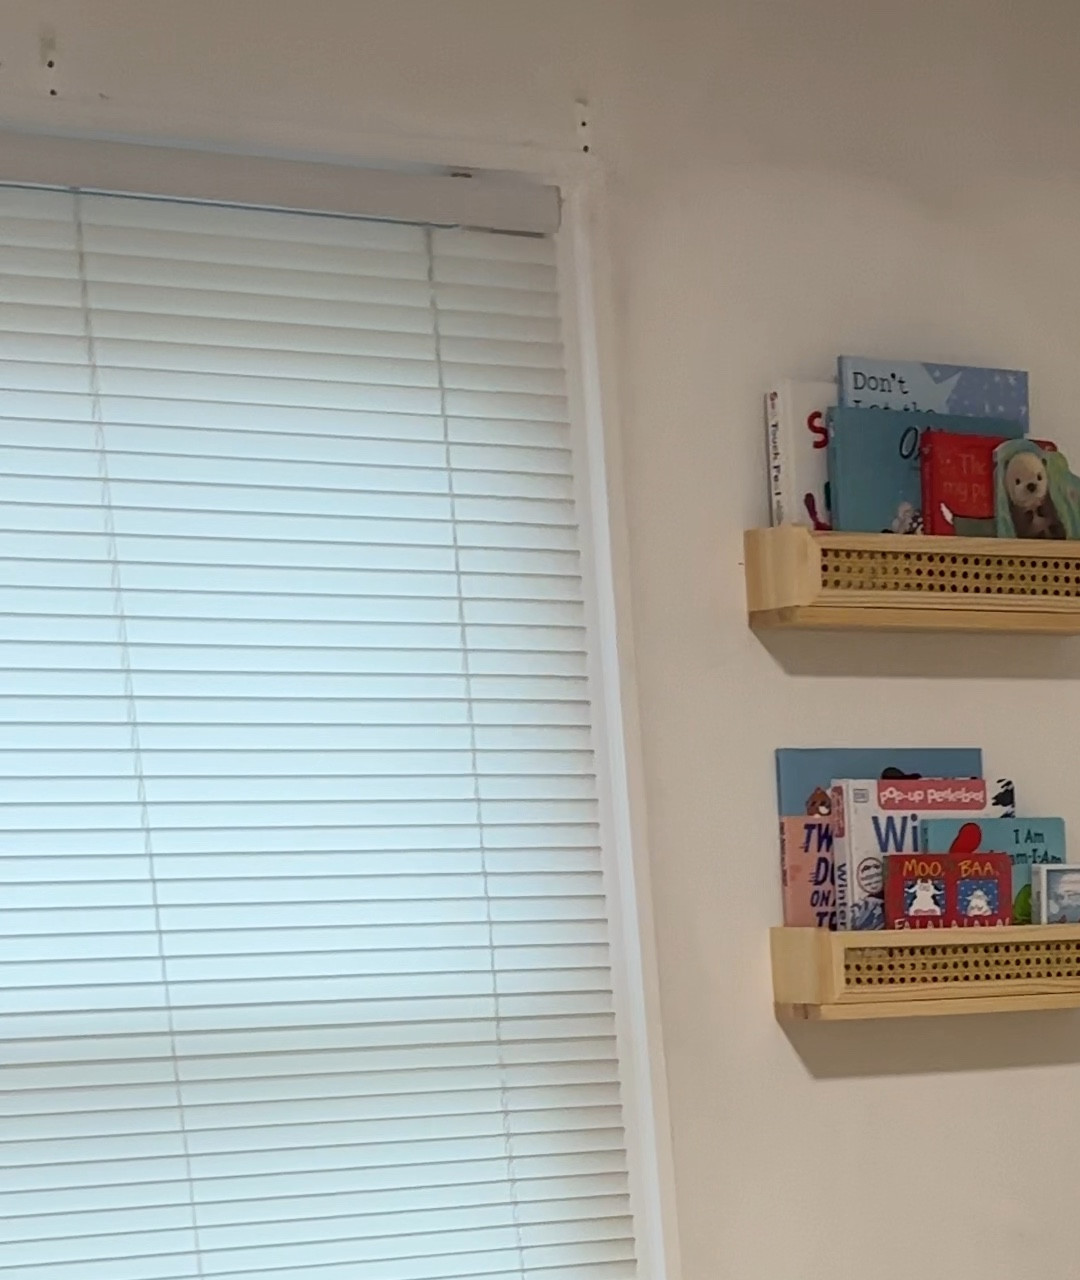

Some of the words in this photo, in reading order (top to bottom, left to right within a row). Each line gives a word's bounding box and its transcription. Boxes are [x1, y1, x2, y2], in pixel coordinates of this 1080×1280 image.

[853, 371, 909, 394] Don't
[1013, 828, 1020, 845] I
[1024, 827, 1045, 844] Am
